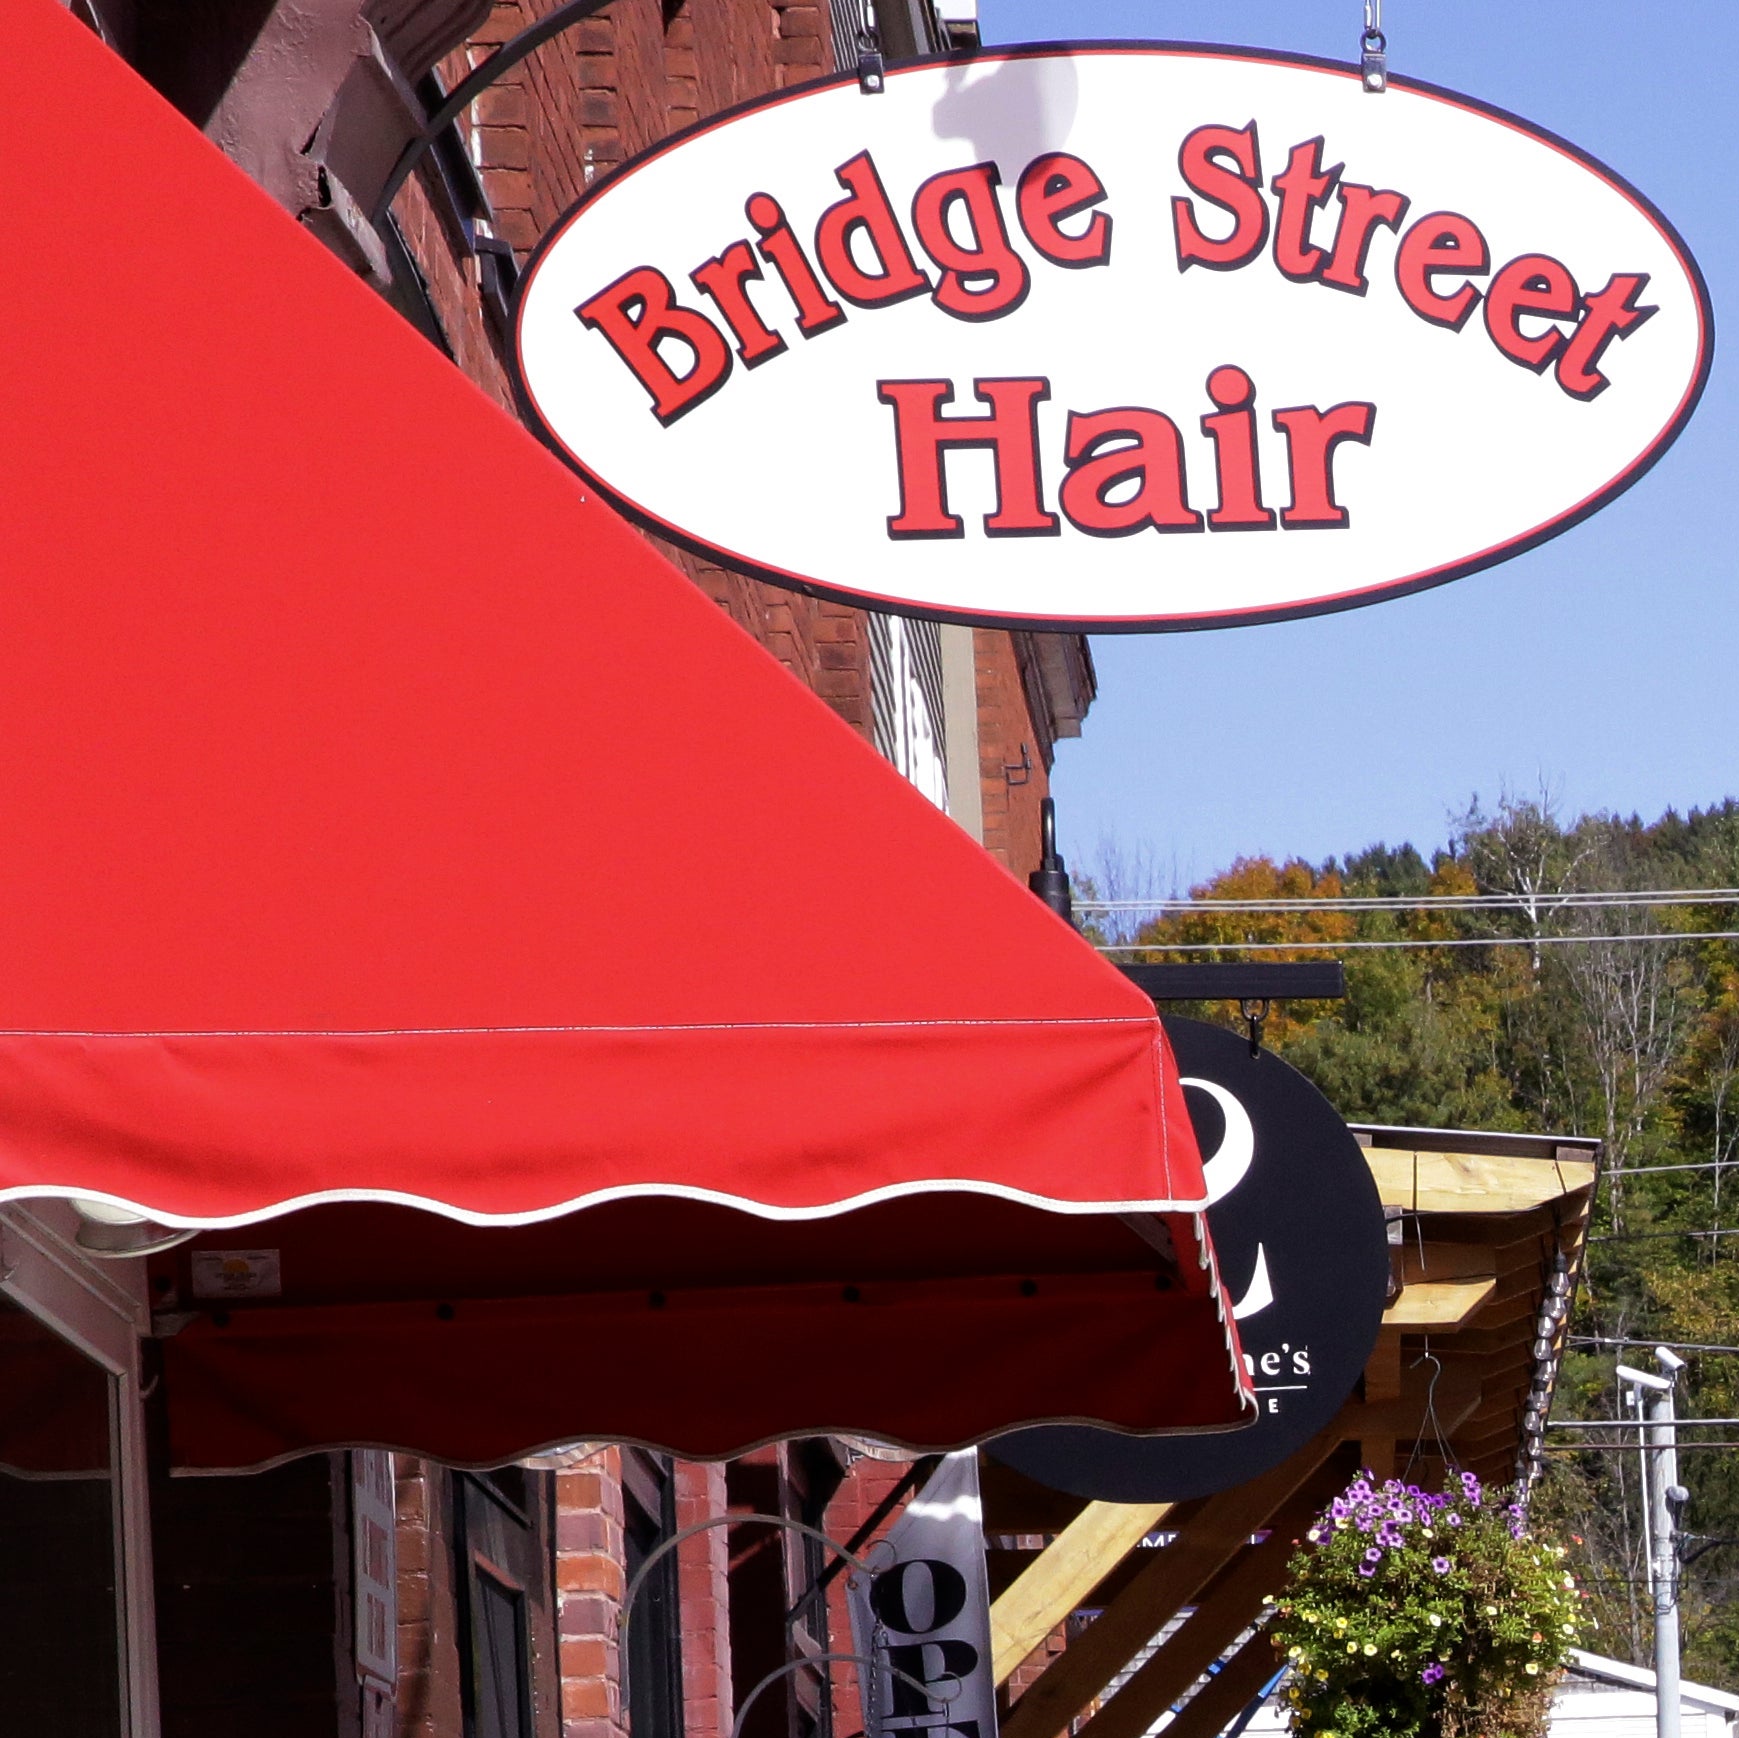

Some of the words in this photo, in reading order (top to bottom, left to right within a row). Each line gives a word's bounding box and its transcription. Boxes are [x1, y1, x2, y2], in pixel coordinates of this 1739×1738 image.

[573, 148, 1112, 428] Bridge
[1171, 119, 1660, 402] Street
[877, 363, 1376, 540] Hair
